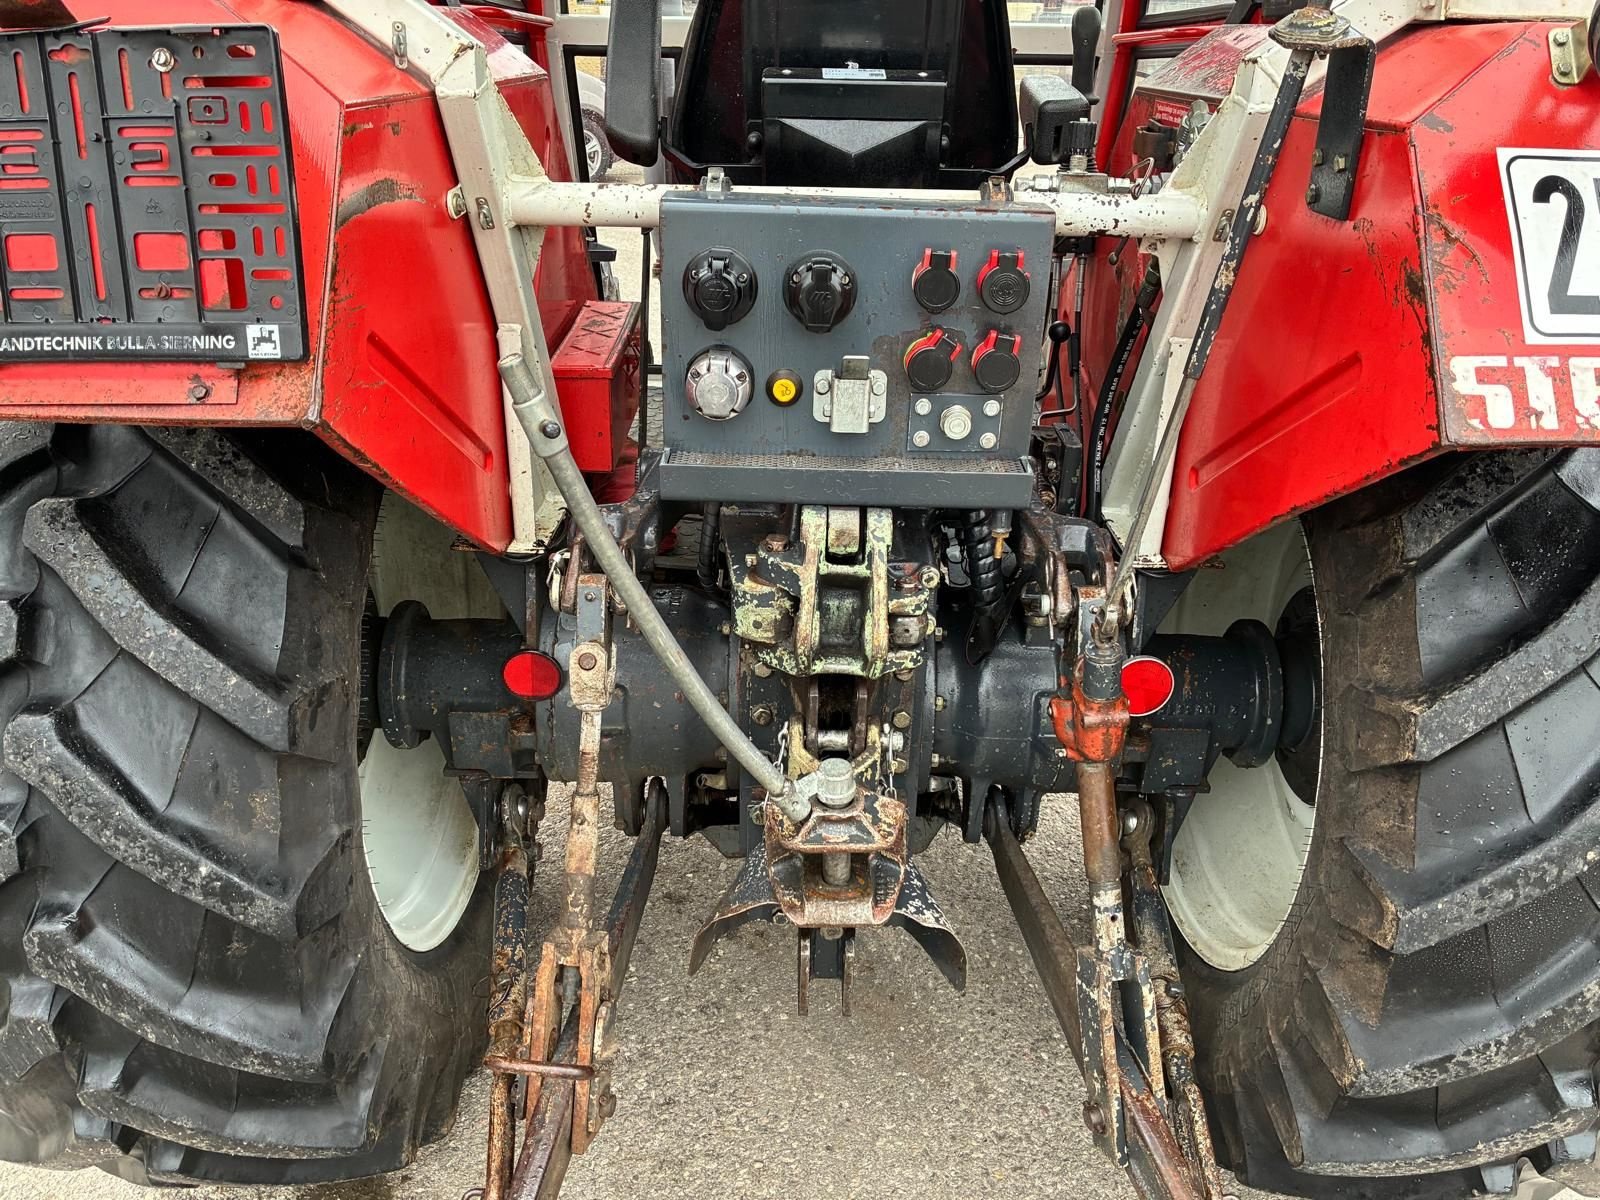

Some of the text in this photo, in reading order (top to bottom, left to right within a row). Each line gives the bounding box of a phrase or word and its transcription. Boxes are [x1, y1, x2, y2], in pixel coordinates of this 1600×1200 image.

[0, 336, 103, 351] ANDTECHNIK
[1126, 339, 1135, 351] BAR
[1110, 377, 1119, 391] BAR
[1104, 403, 1110, 414] WP
[1101, 418, 1107, 426] 12
[1100, 426, 1106, 436] DN
